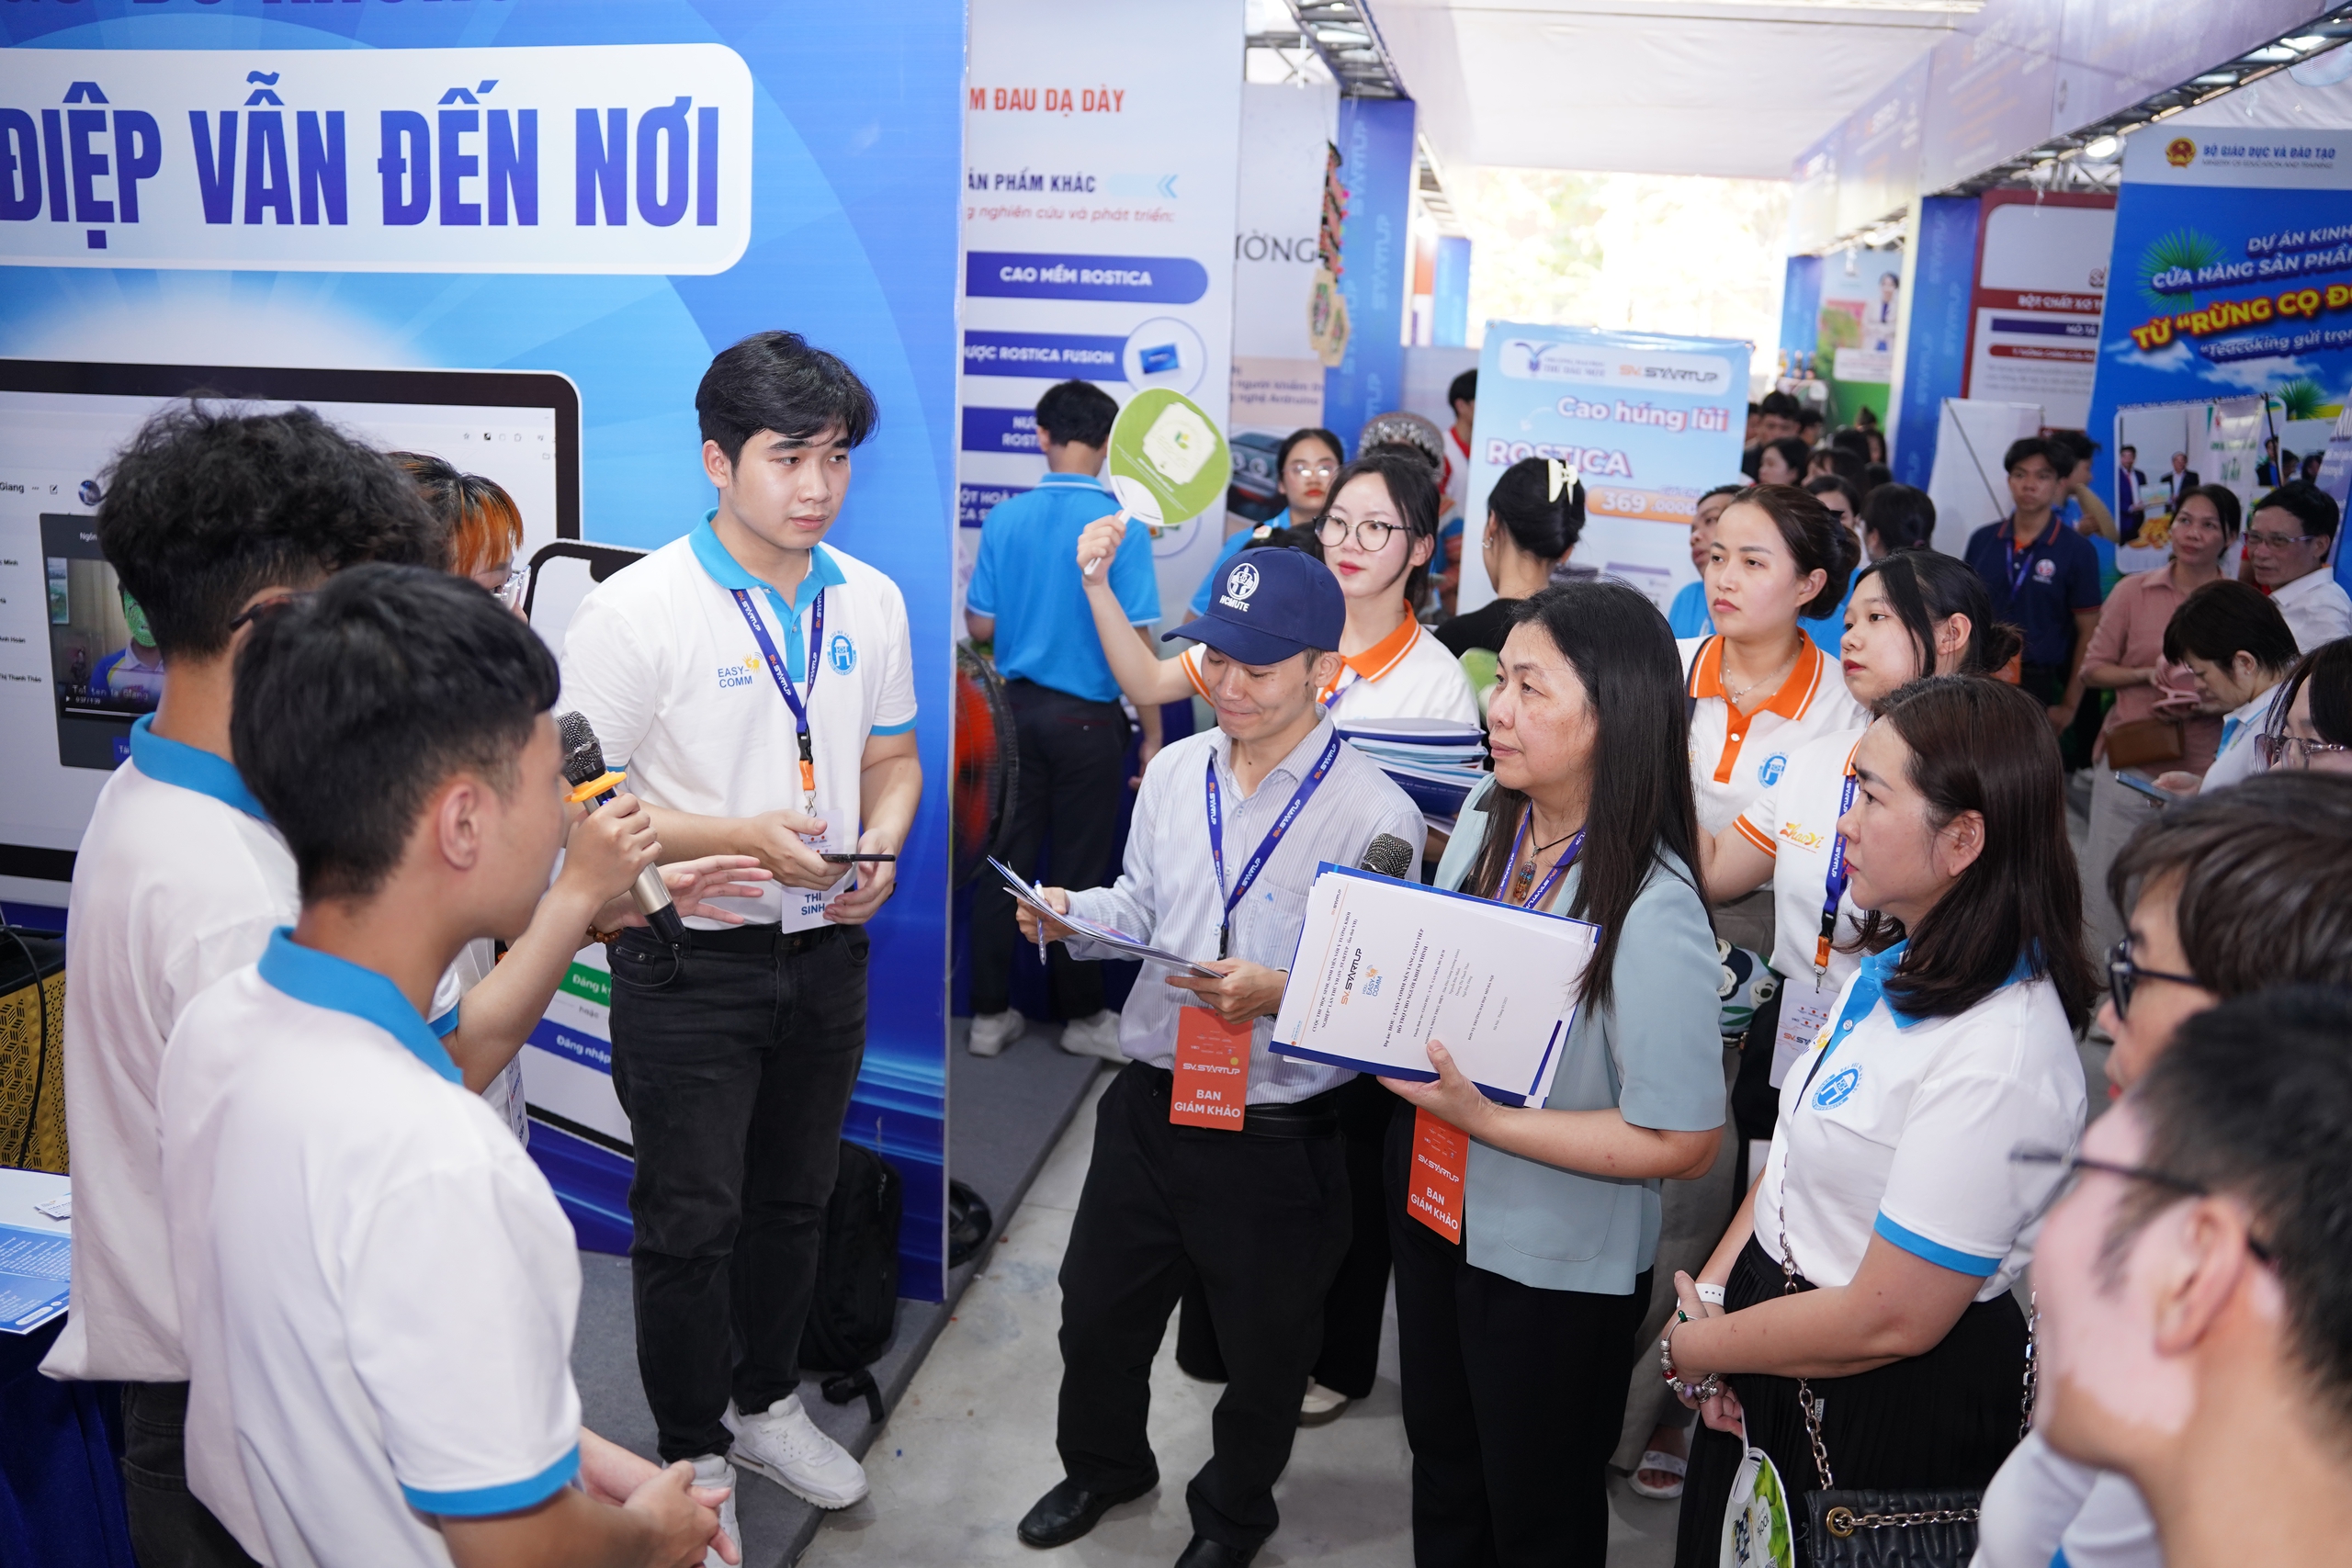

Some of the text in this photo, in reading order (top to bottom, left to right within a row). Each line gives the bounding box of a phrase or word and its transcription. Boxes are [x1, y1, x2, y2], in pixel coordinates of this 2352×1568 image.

[994, 88, 1036, 111] ĐAU
[1046, 89, 1073, 118] DẠ
[1082, 85, 1125, 112] DÀY
[0, 70, 719, 249] ĐIỆP VẪN ĐẾN NƠI
[2203, 143, 2218, 157] BỘ
[2274, 144, 2287, 157] VÀ
[2315, 147, 2335, 160] TẠO
[1051, 172, 1096, 194] KHÁC
[979, 205, 1032, 221] nghiên
[1069, 208, 1086, 220] và
[1091, 206, 1129, 223] phát
[2248, 231, 2277, 253] DỰ
[2278, 229, 2305, 247] ÁN
[1000, 265, 1038, 283] CAO
[1080, 269, 1153, 287] ROSTICA
[2153, 265, 2193, 289] CỬA
[2197, 260, 2254, 285] HÀNG
[2258, 251, 2300, 275] SẢN
[2132, 318, 2172, 351] TỪ
[2278, 288, 2321, 318] CỌ
[1000, 347, 1061, 362] ROSTICA
[1063, 350, 1114, 365] FUSION
[1557, 395, 1728, 432] Cao húng lũi
[1487, 438, 1632, 479] ROSTICA
[1601, 491, 1647, 514] 369
[736, 591, 762, 632] SV.STARTUP
[1219, 594, 1250, 613] HCMUTE
[719, 675, 752, 688] COMM
[768, 654, 792, 696] SV.STARTUP
[1272, 798, 1301, 838] SV.STARTUP
[1237, 857, 1261, 897] SV.STARTUP
[801, 904, 825, 916] SINH
[572, 973, 600, 994] Đăng
[1339, 947, 1363, 1006] SV.STARTUP
[1371, 975, 1384, 998] COMM
[556, 1034, 584, 1055] Đăng
[1182, 1063, 1240, 1076] SV.STARTUP
[1196, 1089, 1222, 1101] BAN
[1174, 1100, 1241, 1118] GIÁM KHẢO
[1418, 1154, 1459, 1183] SV.STARTUP
[1427, 1187, 1445, 1206] BAN
[1410, 1193, 1459, 1230] GIÁM KHẢO
